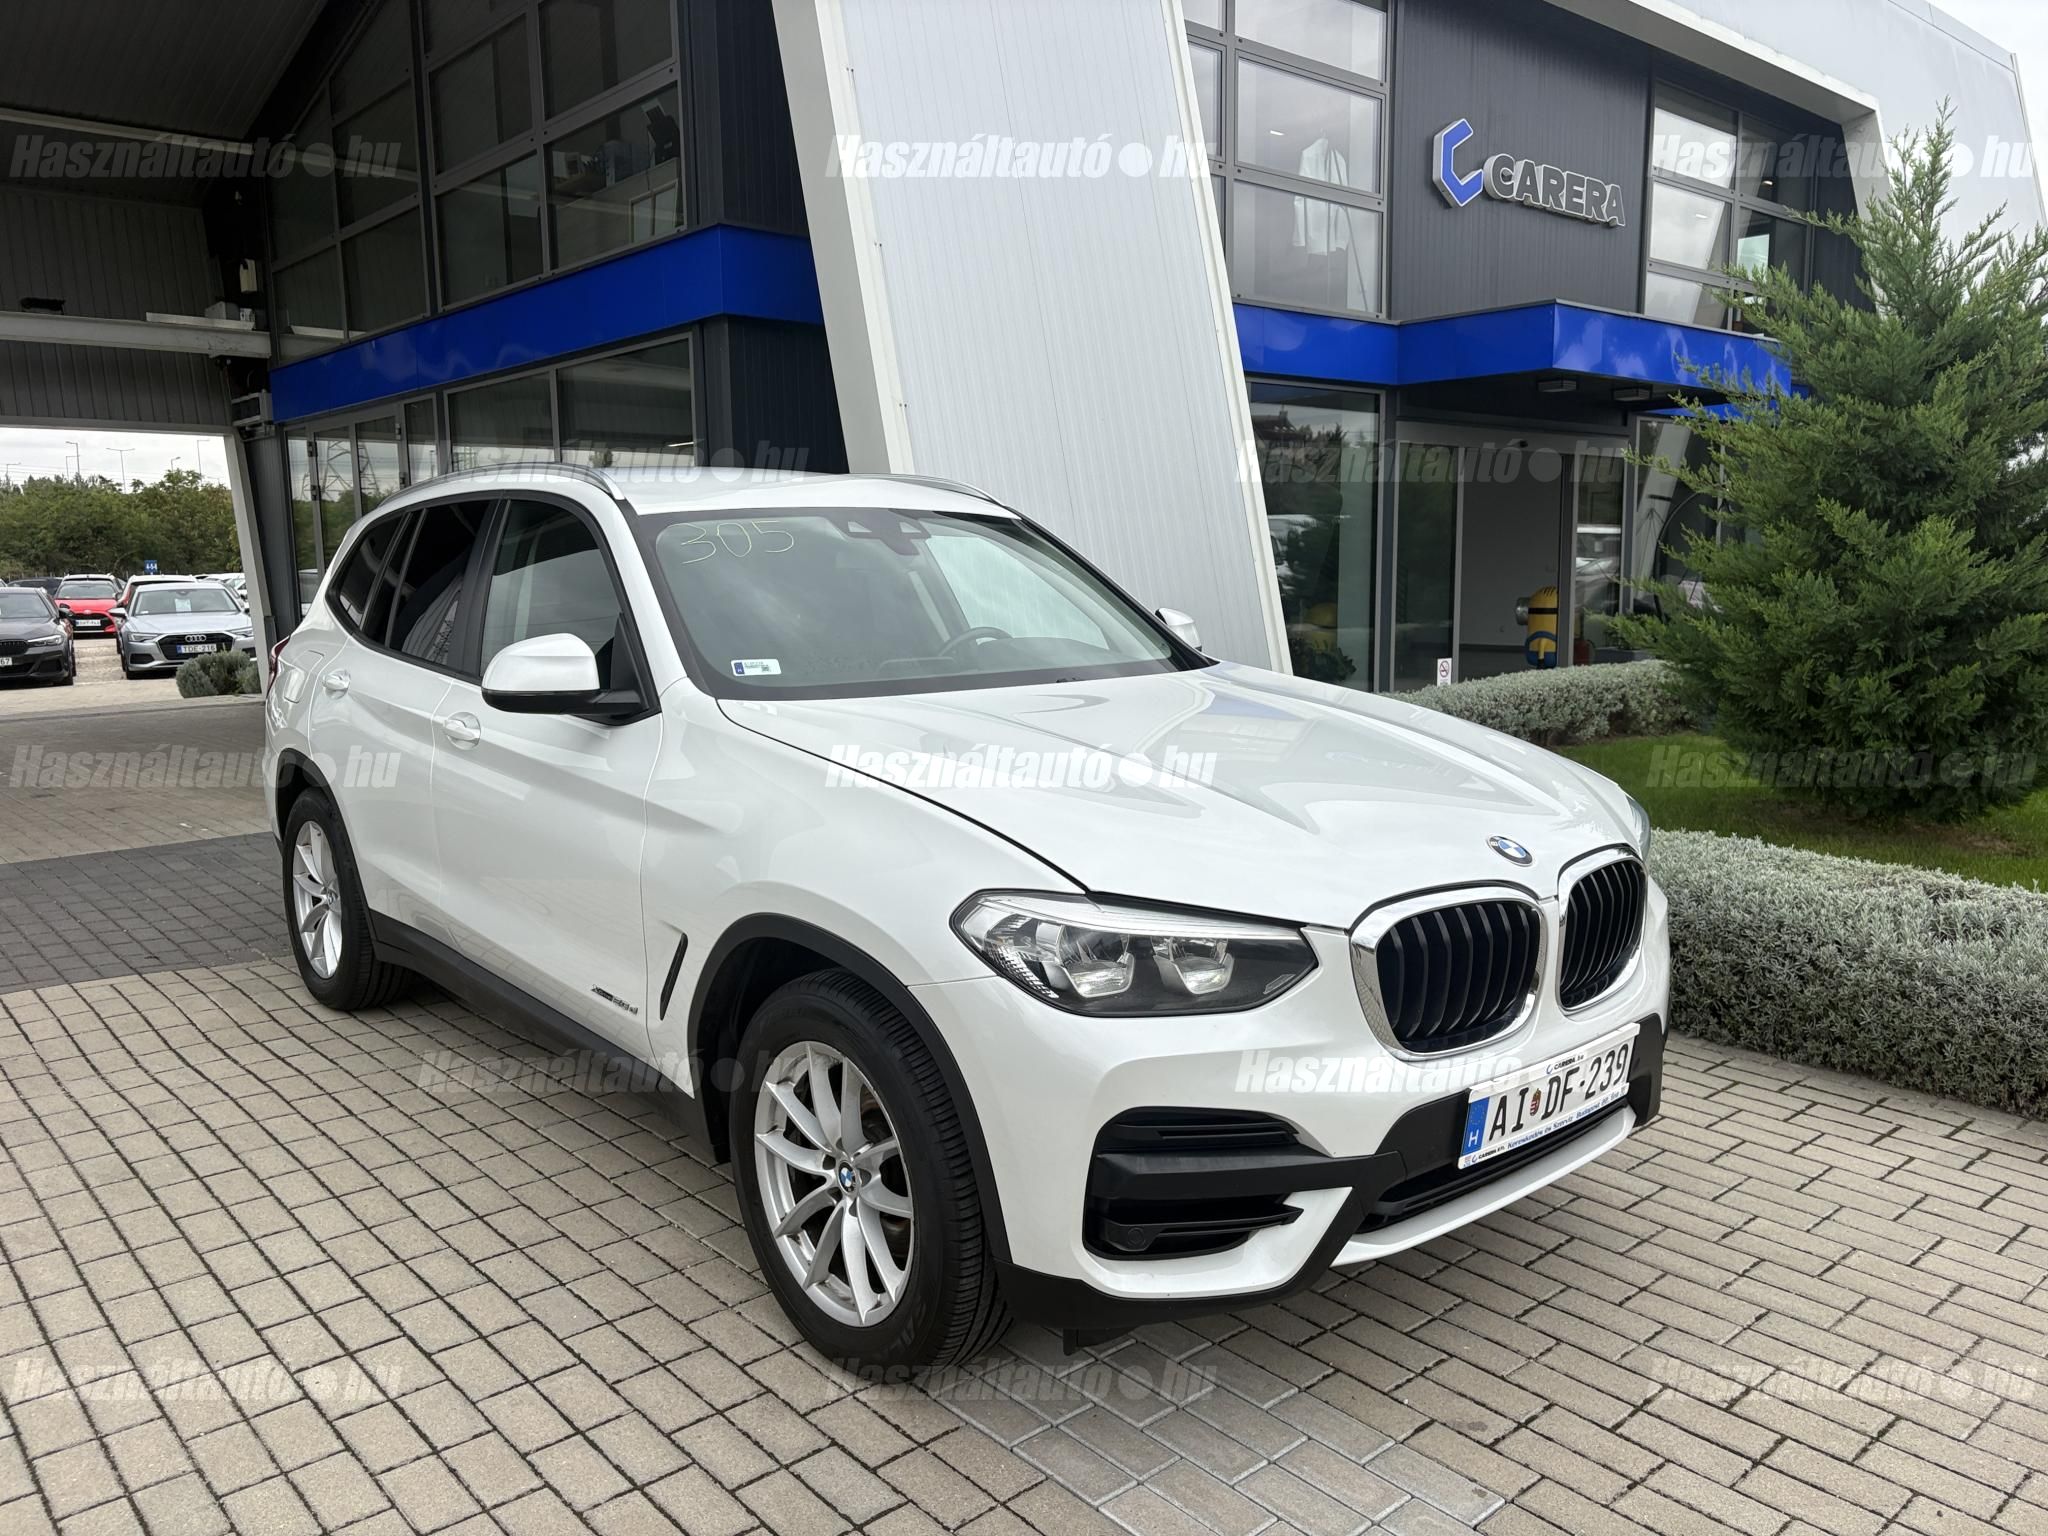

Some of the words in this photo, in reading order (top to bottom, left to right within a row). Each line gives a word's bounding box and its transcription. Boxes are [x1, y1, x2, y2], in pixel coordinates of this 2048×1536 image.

[1484, 153, 1625, 226] CARERA
[669, 521, 794, 564] 305
[1467, 1129, 1480, 1148] H
[1489, 1087, 1529, 1141] AI
[1541, 1043, 1629, 1120] DF-239
